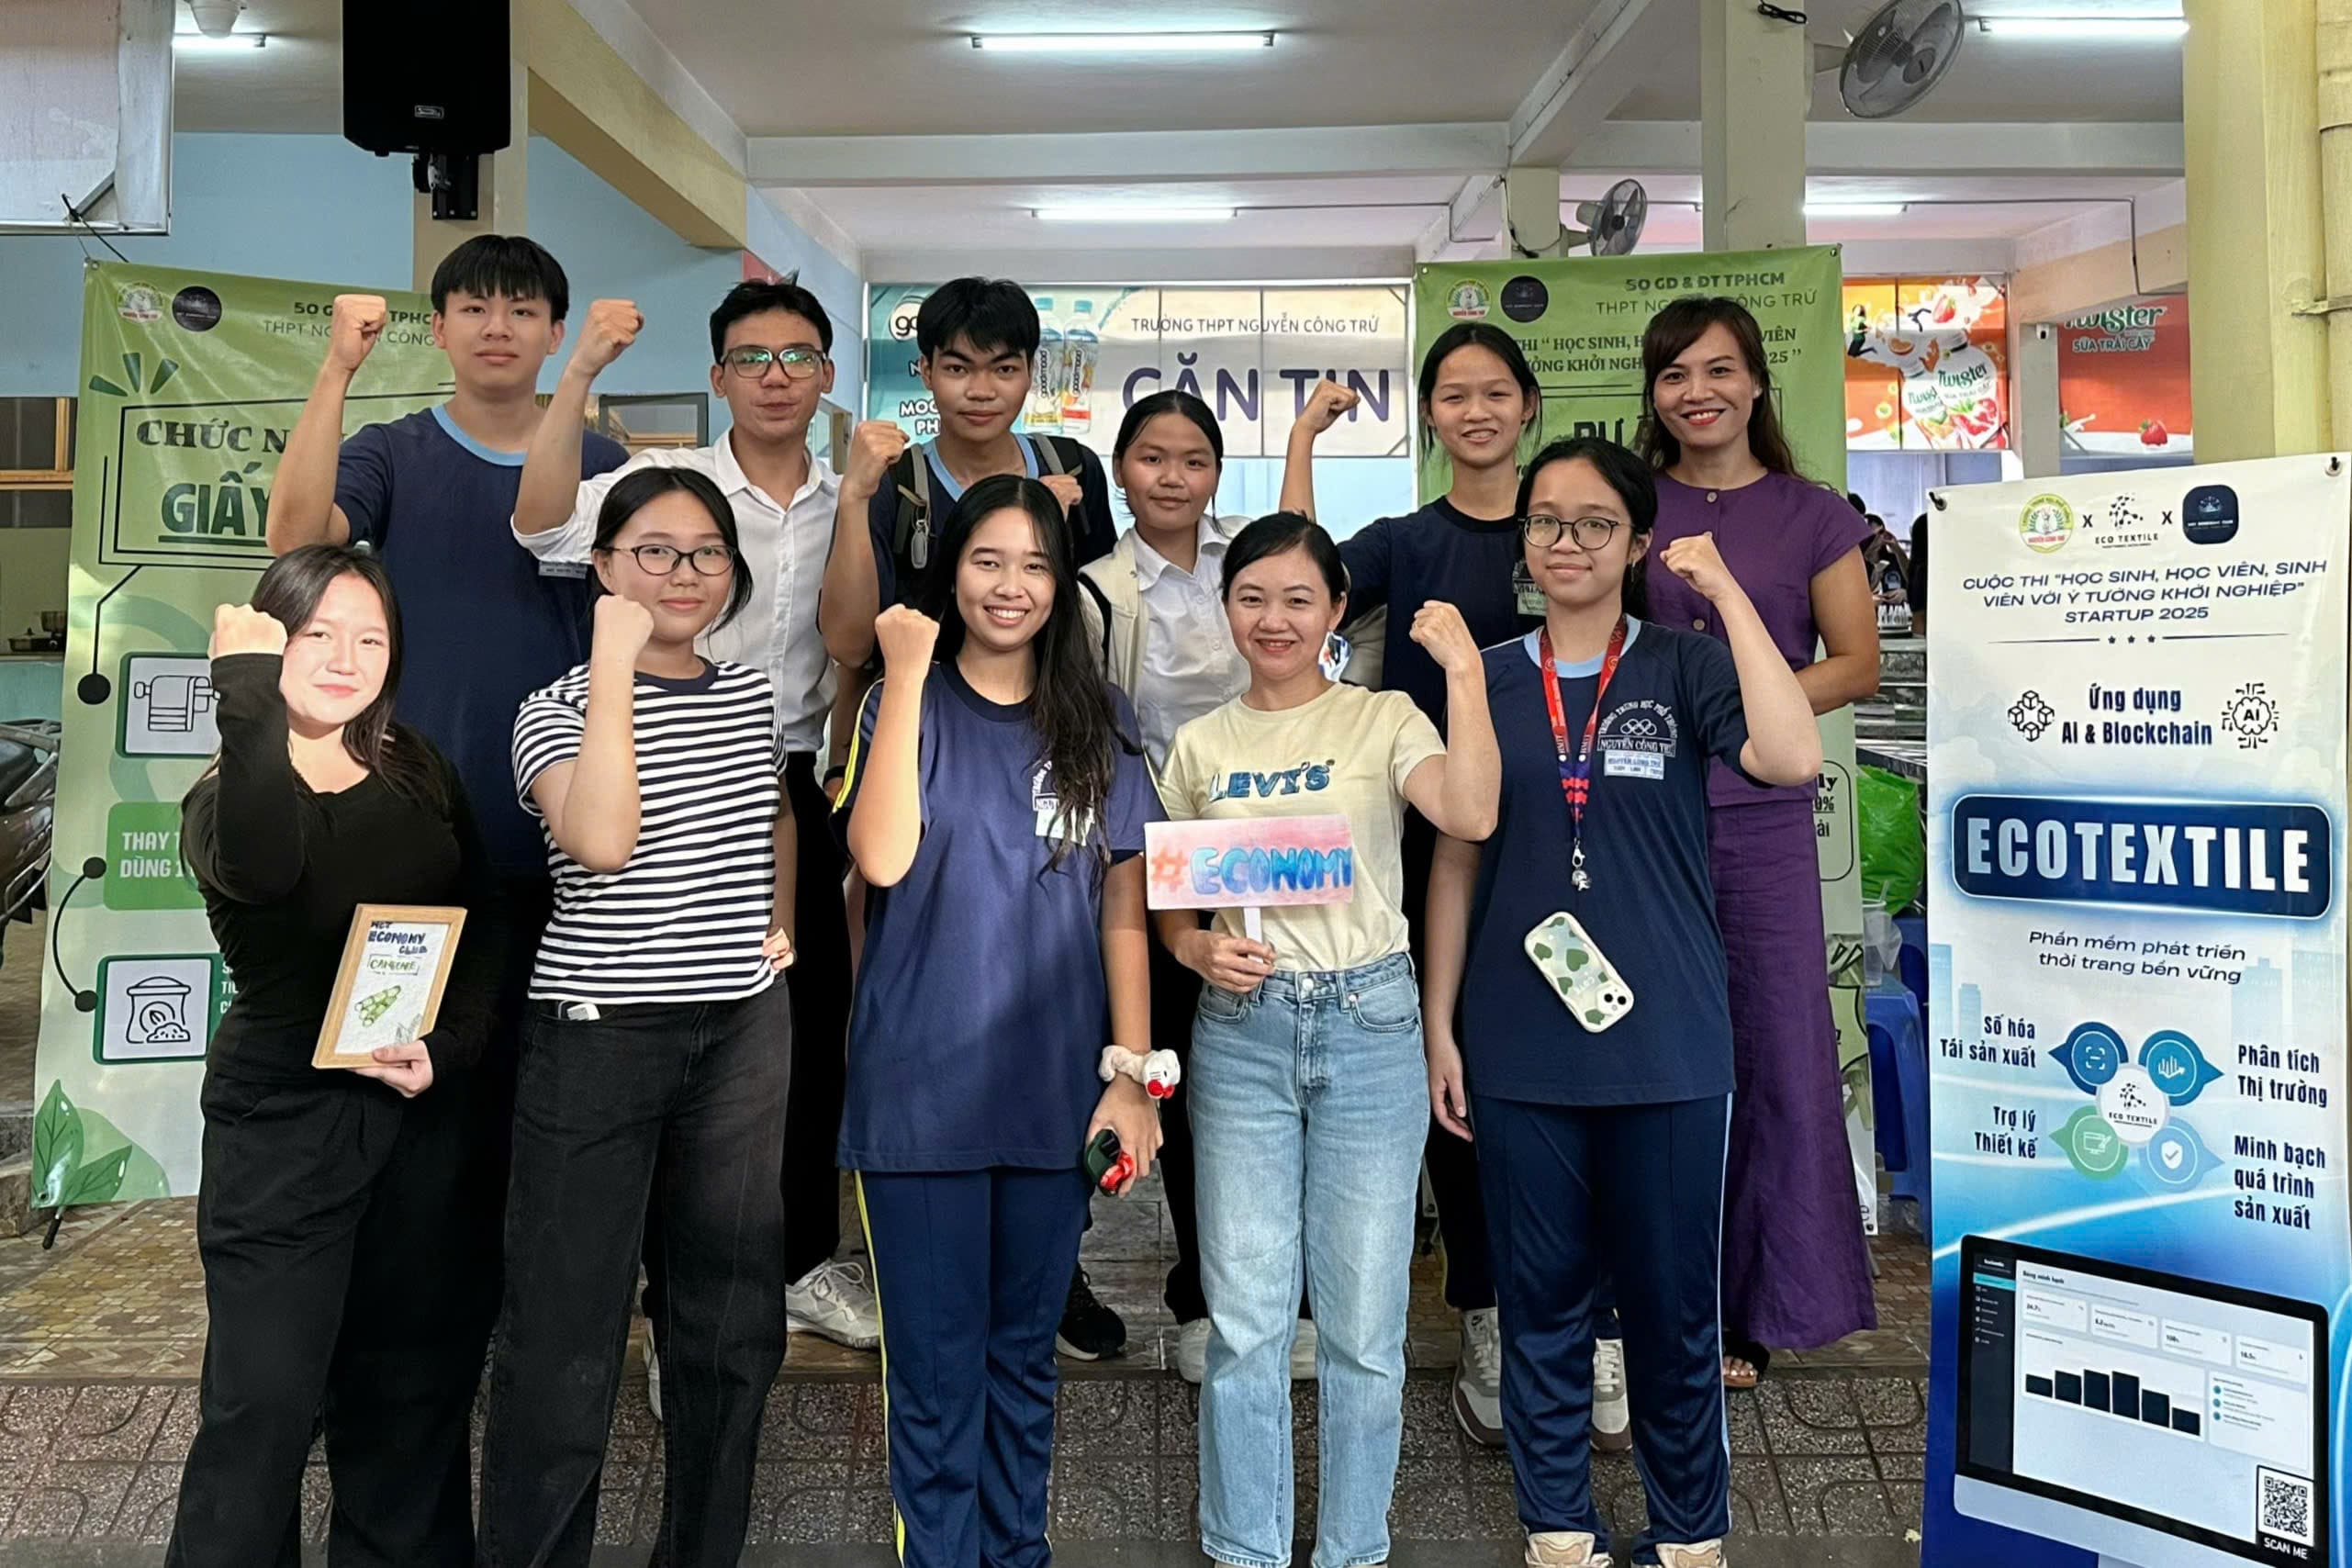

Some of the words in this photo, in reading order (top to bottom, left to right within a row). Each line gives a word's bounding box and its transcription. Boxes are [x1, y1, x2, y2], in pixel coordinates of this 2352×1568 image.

[1654, 277, 1678, 290] GD
[1596, 300, 1639, 315] THPT
[1736, 294, 1776, 309] ÔNG
[263, 320, 304, 337] THPT
[389, 310, 431, 325] TPHC
[1199, 319, 1235, 333] THPT
[1304, 316, 1346, 333] CÔNG
[1553, 337, 1585, 354] HỌC
[1588, 335, 1630, 351] SINH,
[1567, 353, 1606, 372] KHỞI
[1279, 368, 1389, 421] TN
[137, 418, 252, 452] CHỨC
[2095, 535, 2114, 544] ECO
[2118, 532, 2158, 543] TEXTILE
[1963, 574, 2015, 590] CUỘC
[2020, 575, 2049, 588] THI
[2108, 569, 2159, 584] SINH,
[2165, 566, 2212, 581] HỌC
[2275, 560, 2327, 576] SINH
[1983, 592, 2025, 608] VIÊN
[2065, 609, 2155, 624] STARTUP
[2158, 606, 2210, 621] 2025
[2089, 682, 2126, 712] Ứng
[2133, 687, 2182, 715] dụng
[2243, 709, 2260, 722] AI
[2062, 721, 2078, 745] AI
[2084, 723, 2096, 745] &
[2102, 721, 2212, 745] Blockchain
[121, 832, 170, 851] THAY
[120, 855, 172, 878] DÙNG
[1967, 817, 2310, 892] ECOTEXTILE
[2142, 940, 2191, 957] phát
[2081, 956, 2134, 975] trang
[2187, 965, 2242, 985] vững
[1984, 1014, 2004, 1036] Số
[2008, 1017, 2036, 1039] hóa
[1940, 1037, 1964, 1059] Tái
[1968, 1039, 1998, 1063] sản
[2002, 1045, 2036, 1068] xuất
[2238, 1044, 2280, 1069] Phân
[2287, 1048, 2320, 1074] tích
[2238, 1075, 2263, 1102] Thị
[2269, 1079, 2327, 1108] trường
[1993, 1105, 2018, 1131] Trợ
[2022, 1109, 2036, 1132] lý
[1975, 1131, 2012, 1156] Thiết
[2018, 1137, 2038, 1159] kế
[2234, 1135, 2277, 1160] Minh
[2284, 1142, 2325, 1170] bạch
[2234, 1168, 2266, 1191] quá
[2272, 1171, 2314, 1199] trình
[2234, 1194, 2266, 1222] sản
[2272, 1204, 2311, 1230] xuất
[2263, 1537, 2290, 1554] SCAN
[2292, 1545, 2308, 1561] ME
